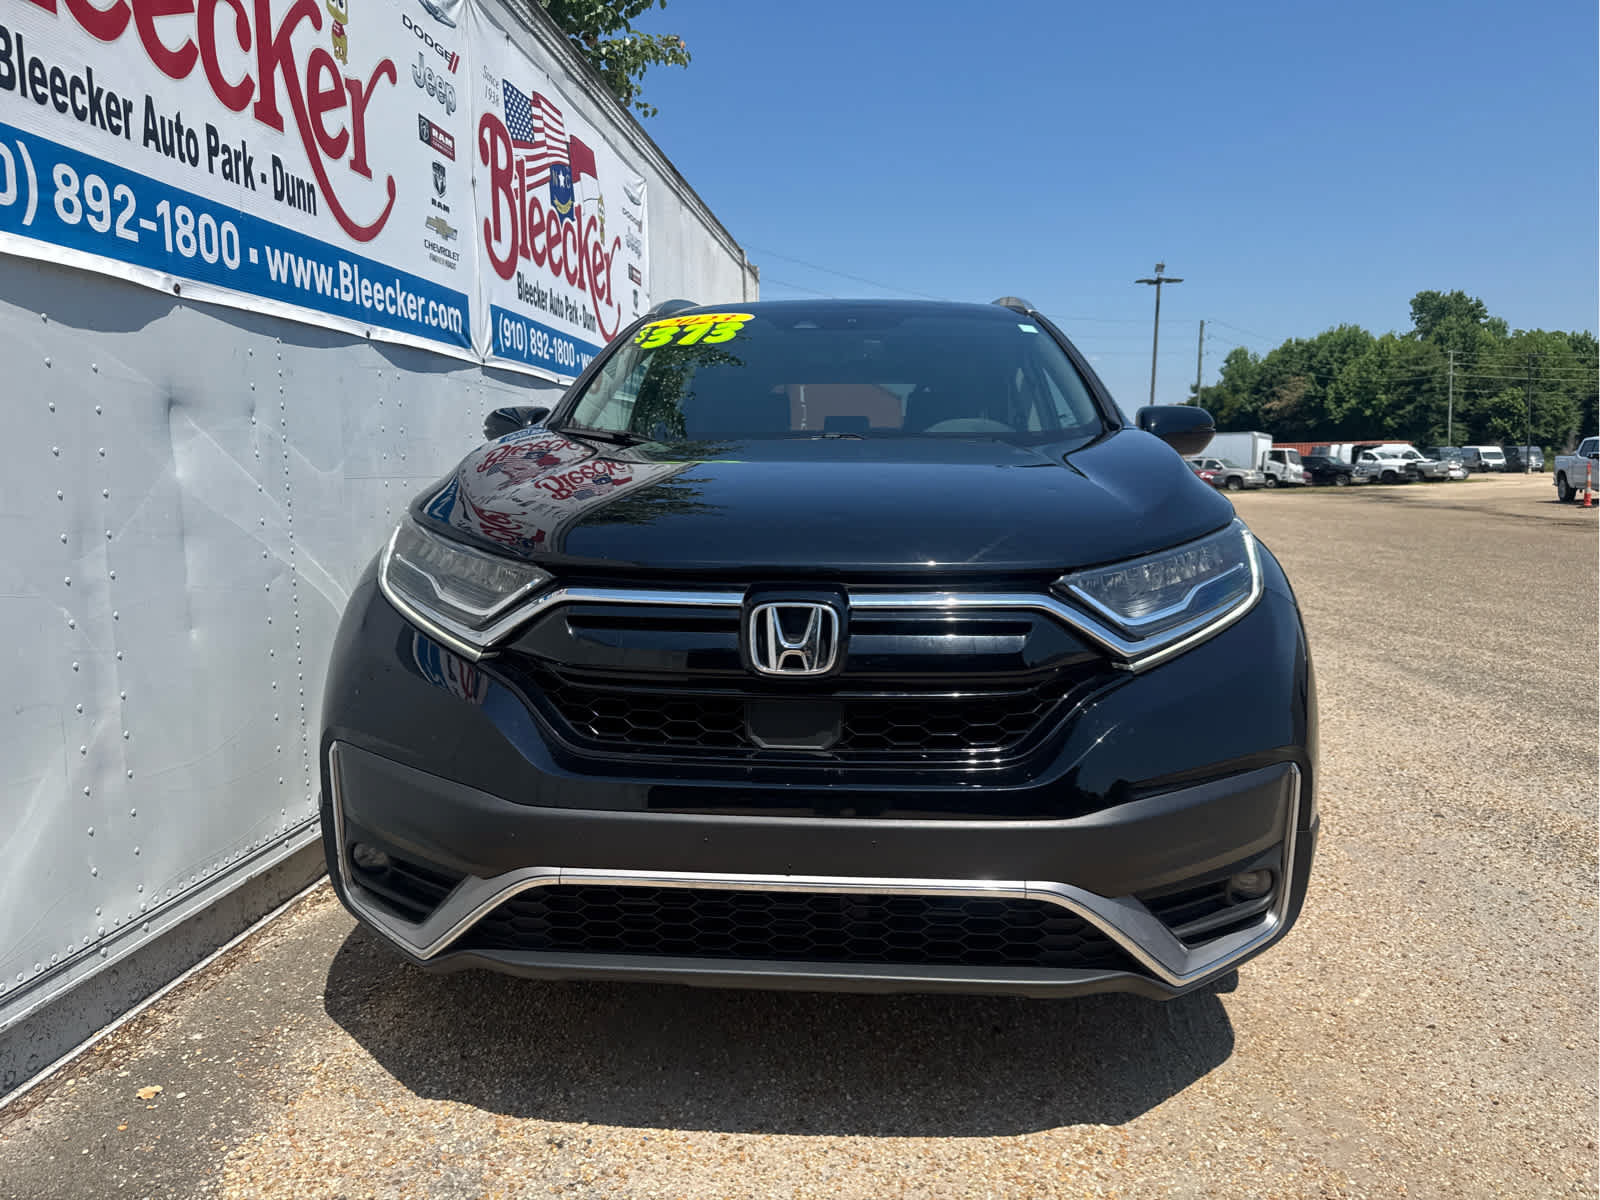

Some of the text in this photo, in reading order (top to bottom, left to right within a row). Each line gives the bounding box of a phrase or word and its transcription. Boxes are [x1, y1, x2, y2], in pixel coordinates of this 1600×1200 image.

[402, 14, 454, 67] DODGE
[411, 51, 456, 116] Jeep
[0, 25, 133, 140] Bleecker
[143, 95, 199, 167] Auto
[206, 123, 256, 191] Park
[272, 154, 317, 216] Dunn
[431, 127, 453, 149] RAM
[431, 197, 450, 214] RAM
[479, 112, 621, 344] Bleecker
[52, 162, 241, 271] 892-1800
[264, 245, 464, 334] www.Bleecker.com
[424, 238, 460, 262] CHEVROLET
[517, 270, 548, 313] Bleecker
[550, 288, 564, 319] Auto
[565, 296, 579, 326] Park
[499, 312, 527, 359] (910)
[530, 327, 575, 368] 892-1800
